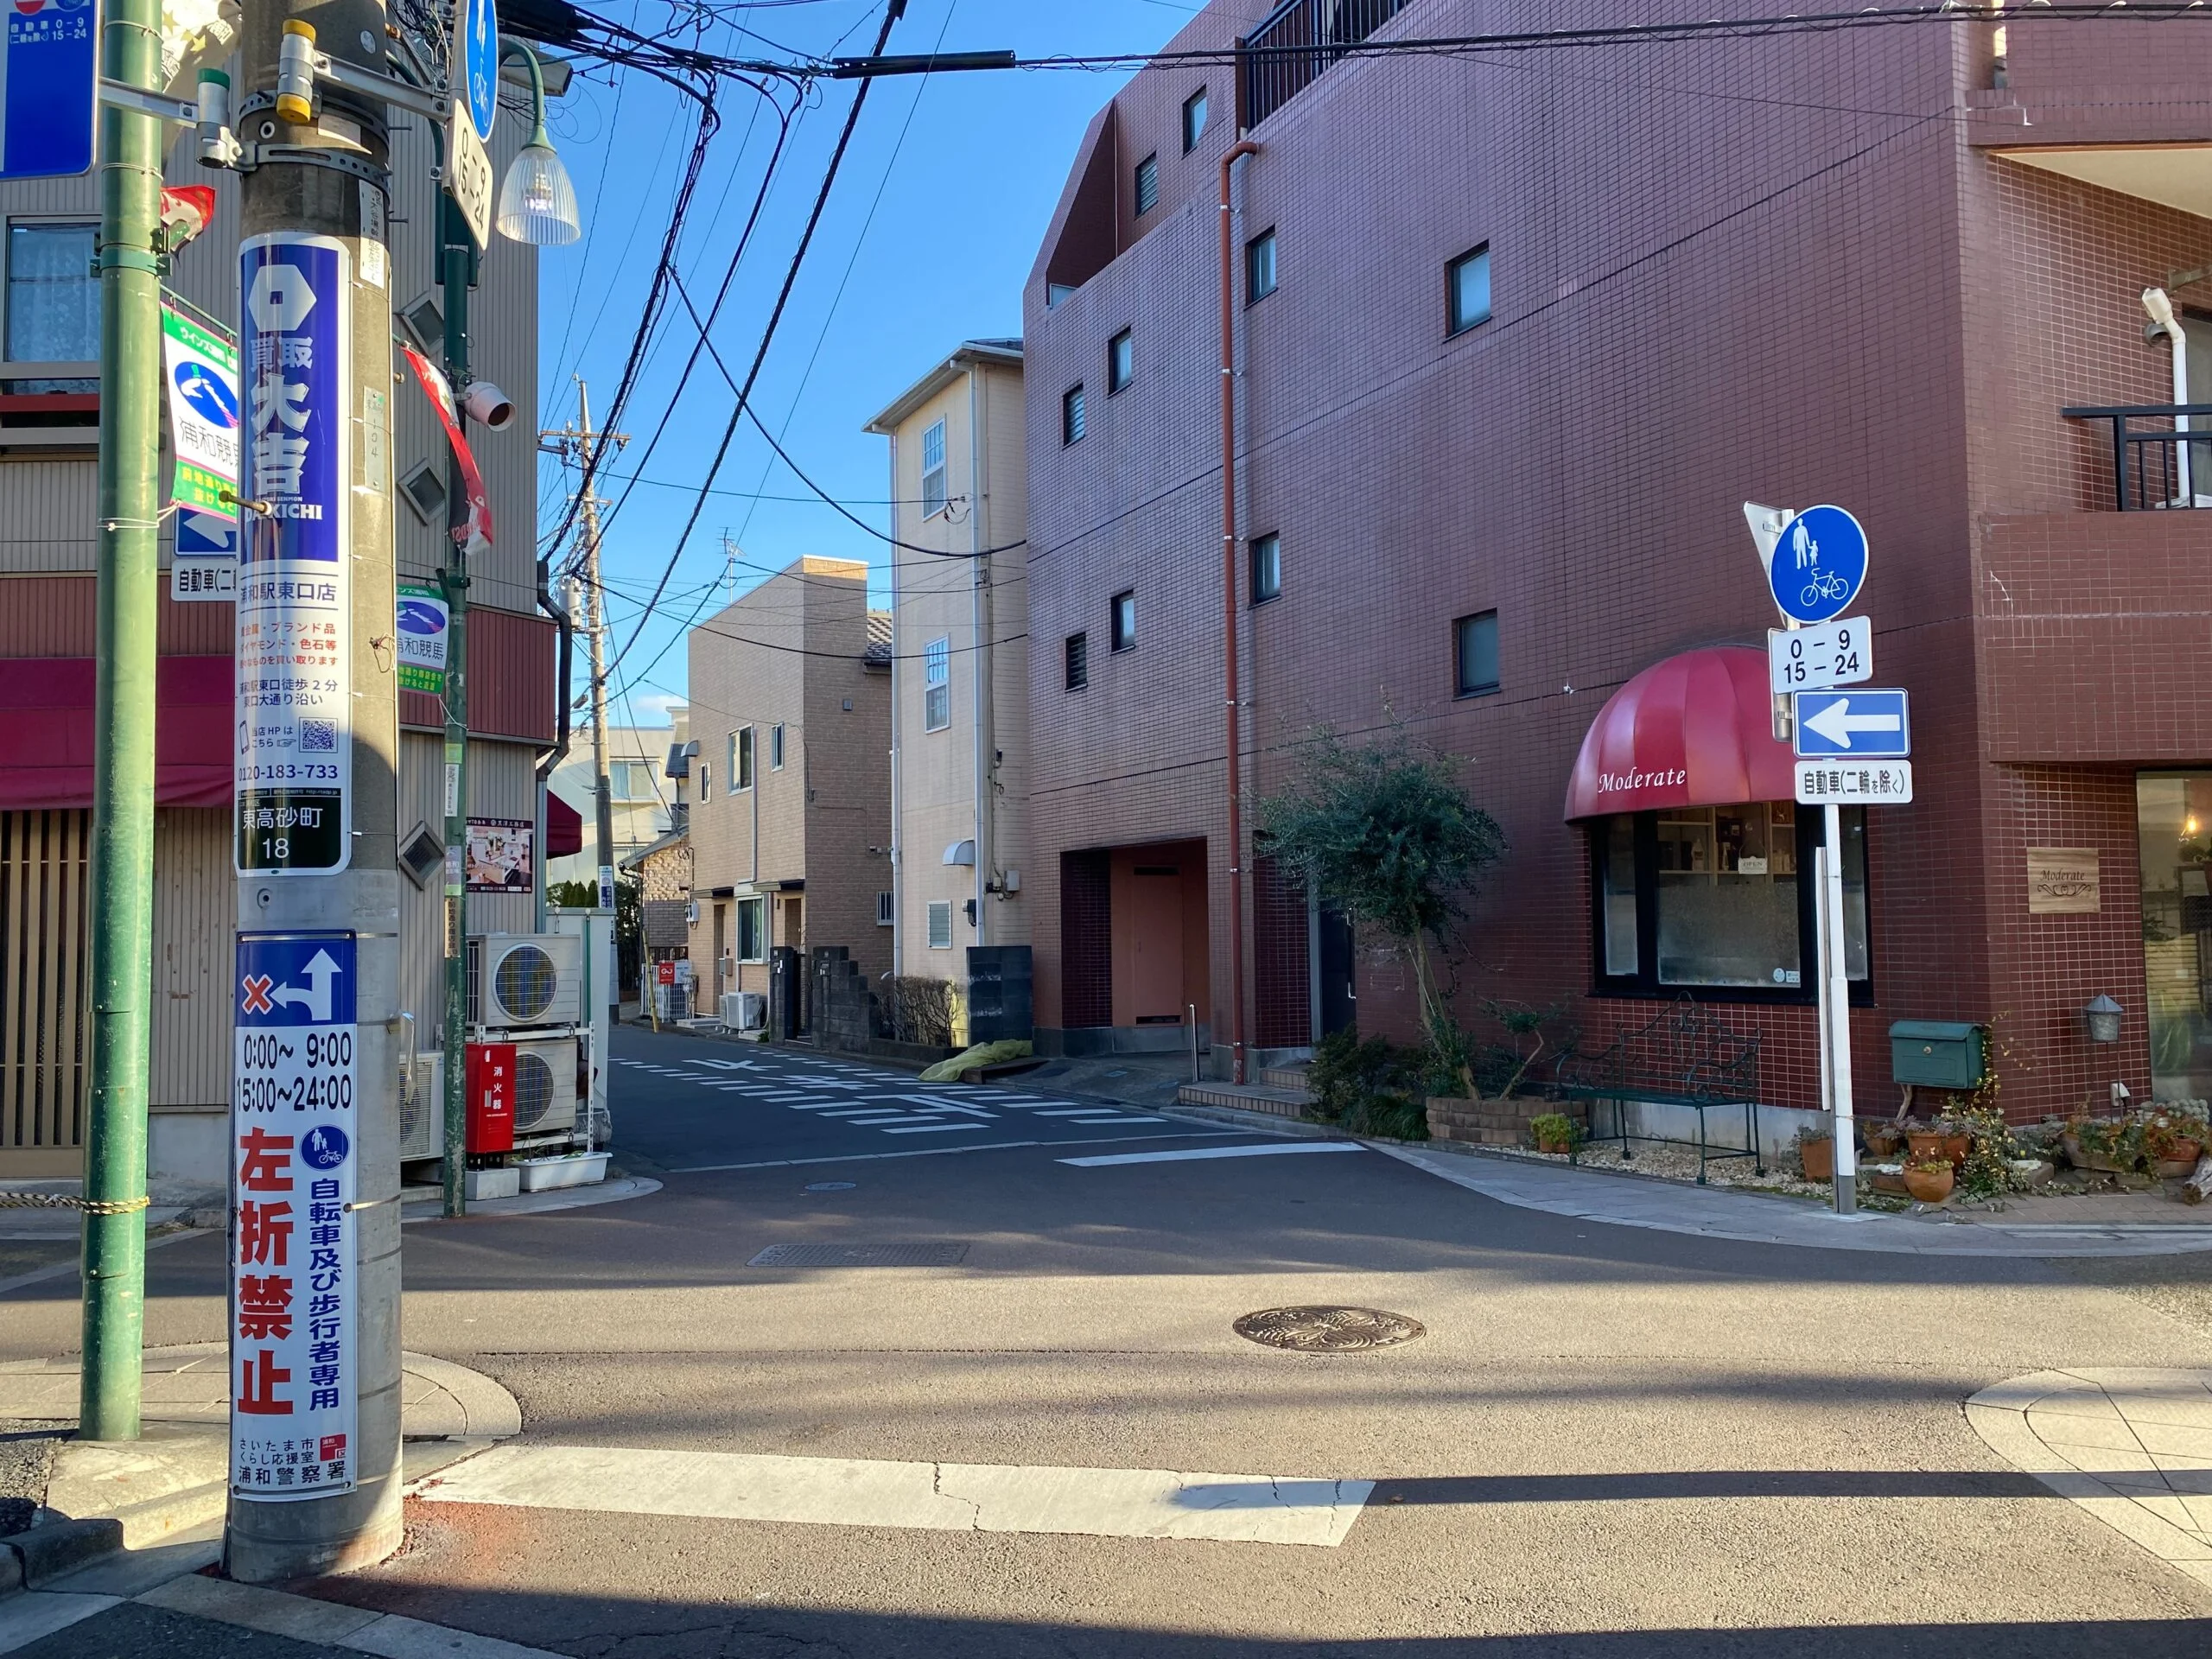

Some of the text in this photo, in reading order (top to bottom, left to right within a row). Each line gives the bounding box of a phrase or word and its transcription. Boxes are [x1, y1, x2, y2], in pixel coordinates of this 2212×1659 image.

[251, 336, 314, 372] 買取
[250, 372, 312, 496] 大吉
[179, 568, 236, 594] 自動車(二
[238, 764, 339, 782] 0120-183-733
[1598, 766, 1686, 794] Moderate
[243, 806, 324, 830] 東高砂町
[262, 837, 290, 860] 18
[2039, 867, 2086, 881] Moderate
[493, 1065, 503, 1109] 消火器
[238, 1126, 295, 1415] 左折禁止
[308, 1178, 343, 1412] 自転車及び歩行者専用
[239, 1437, 315, 1452] さいたま市
[240, 1451, 315, 1465] くらし応援室
[238, 1460, 346, 1486] 浦和警察署
